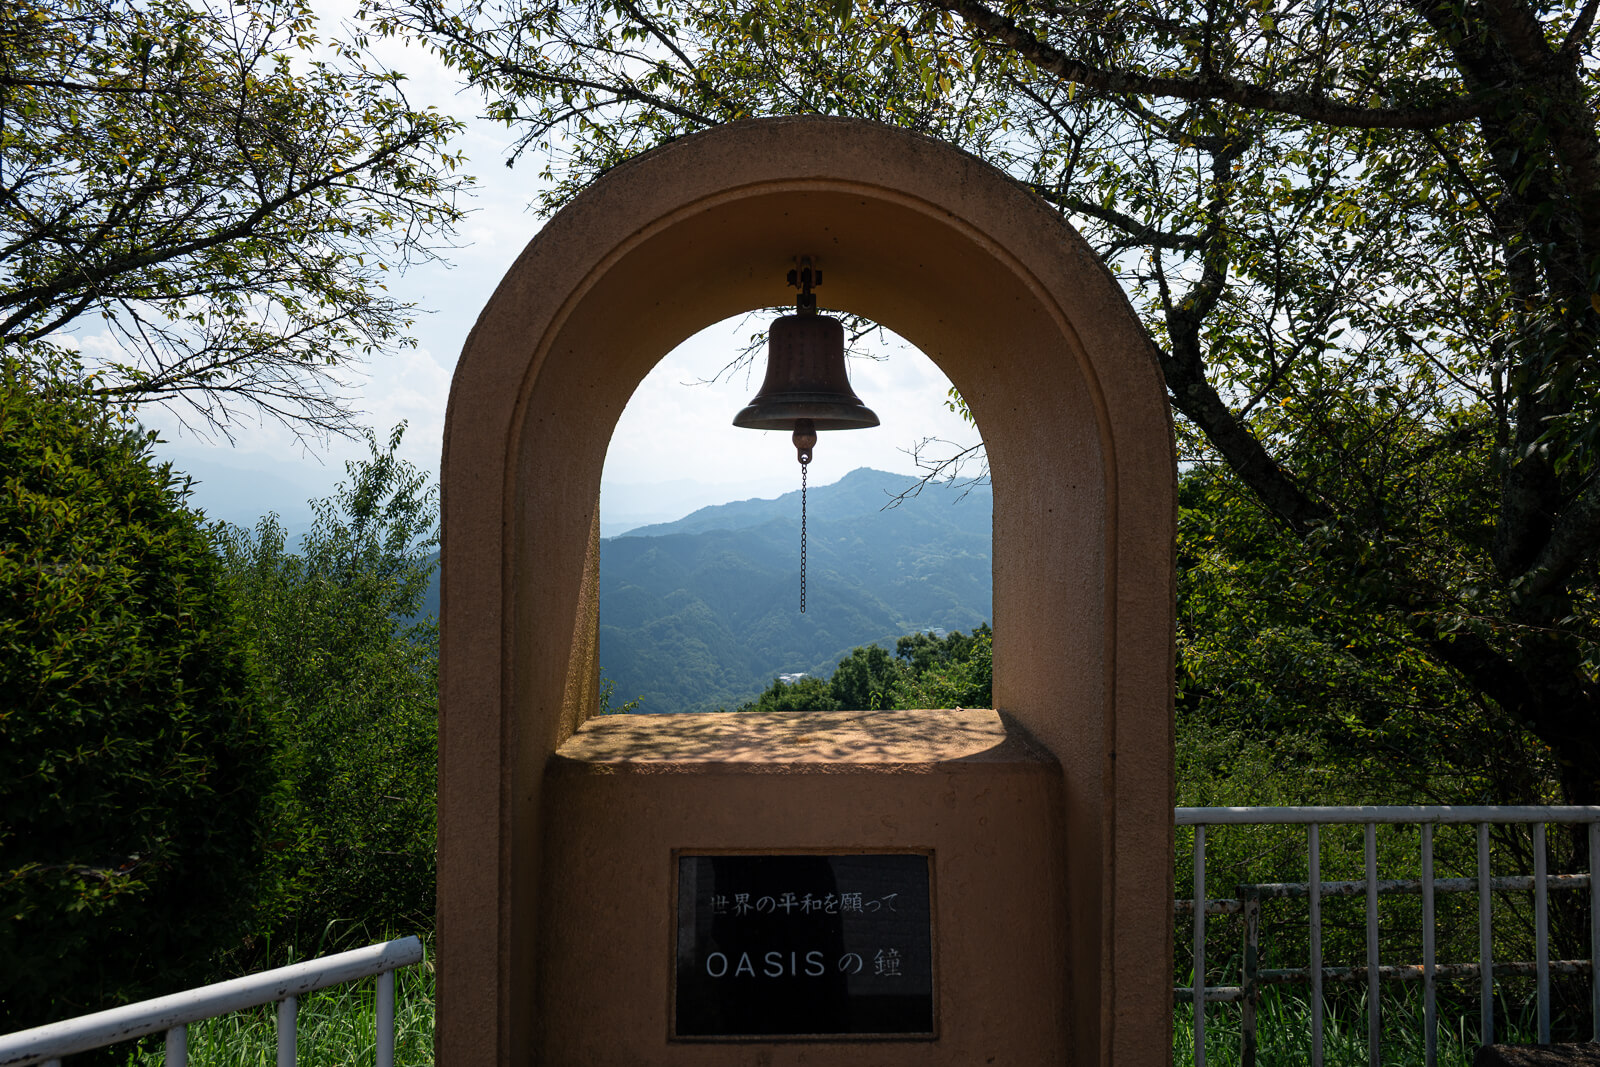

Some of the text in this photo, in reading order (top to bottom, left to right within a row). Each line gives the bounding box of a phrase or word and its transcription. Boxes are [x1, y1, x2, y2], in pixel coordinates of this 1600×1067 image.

[710, 892, 899, 917] 世界の平和を願って
